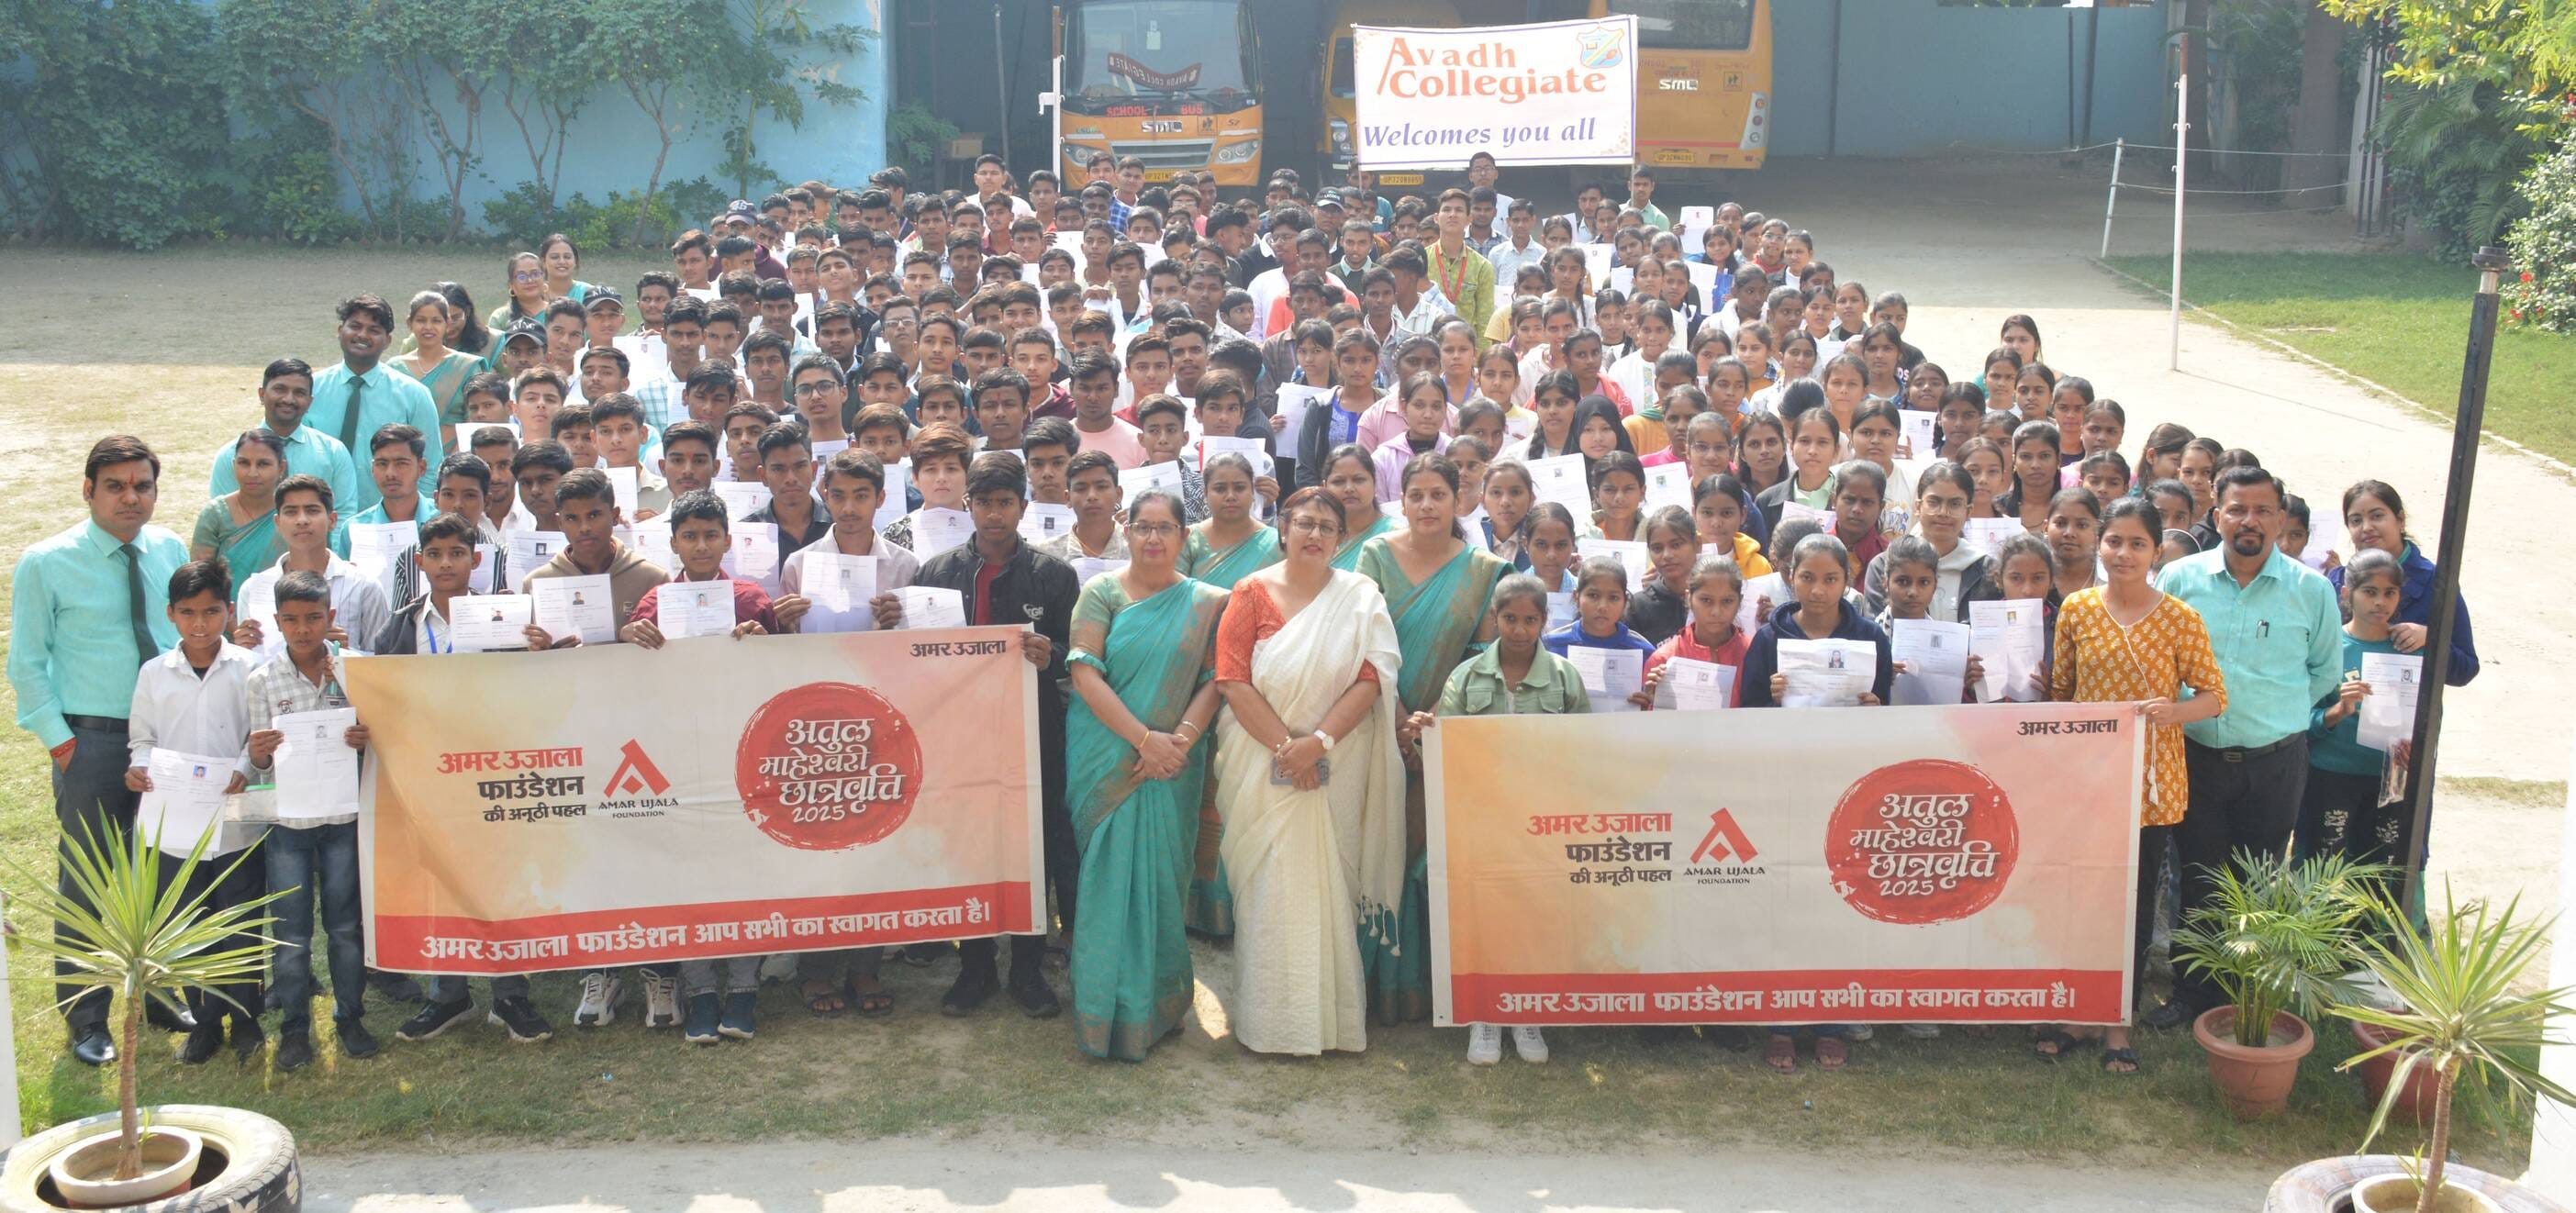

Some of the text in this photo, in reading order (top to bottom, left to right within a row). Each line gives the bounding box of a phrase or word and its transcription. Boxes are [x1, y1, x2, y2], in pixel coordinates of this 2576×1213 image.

[1377, 37, 1517, 95] Avadh
[1389, 68, 1606, 104] Collegiate
[1659, 79, 1698, 90] SML
[1107, 103, 1203, 117] SCHOOL BUS
[1142, 121, 1183, 132] SML
[1364, 117, 1596, 148] Welcomes you all
[511, 318, 536, 331] KING
[909, 640, 1006, 657] अमर उजाला
[786, 718, 875, 752] अतुल
[2017, 718, 2118, 736] अमर उजाला
[436, 747, 583, 773] अमर उजाला
[759, 745, 871, 778] माहेश्वरी
[477, 772, 585, 800] फाउंडेशन
[778, 763, 907, 814] छात्रवृत्ति
[484, 804, 586, 823] की अनूठी पहल
[598, 797, 679, 809] AMAR UJALA
[612, 809, 665, 818] FOUNDATION
[793, 806, 846, 823] 2025
[1879, 794, 1975, 827] अतुल
[1527, 812, 1672, 836] अमर उजाला
[1849, 820, 1966, 852] माहेश्वरी
[1566, 835, 1672, 862] फाउंडेशन
[1569, 866, 1672, 886] की अनूठी पहल
[1684, 866, 1766, 876] AMAR UJALA
[1868, 840, 2001, 889] छात्रवृत्ति
[1697, 877, 1751, 885] FOUNDATION
[1879, 880, 1934, 896] 2025
[420, 935, 484, 959] अमर
[485, 935, 568, 961] उजाला
[575, 921, 686, 952] फाउंडेशन
[694, 921, 739, 943] आप
[743, 911, 790, 940] सभी
[791, 917, 827, 938] का
[828, 910, 900, 935] स्वागत
[902, 905, 963, 928] करता
[1496, 992, 1561, 1013] अमर
[1563, 993, 1645, 1012] उजाला
[1653, 984, 1763, 1012] फाउंडेशन
[1770, 989, 1816, 1008] आप
[1820, 982, 1867, 1007] सभी
[1868, 989, 1903, 1007] का
[1906, 988, 1981, 1008] स्वागत
[1984, 989, 2047, 1007] करता
